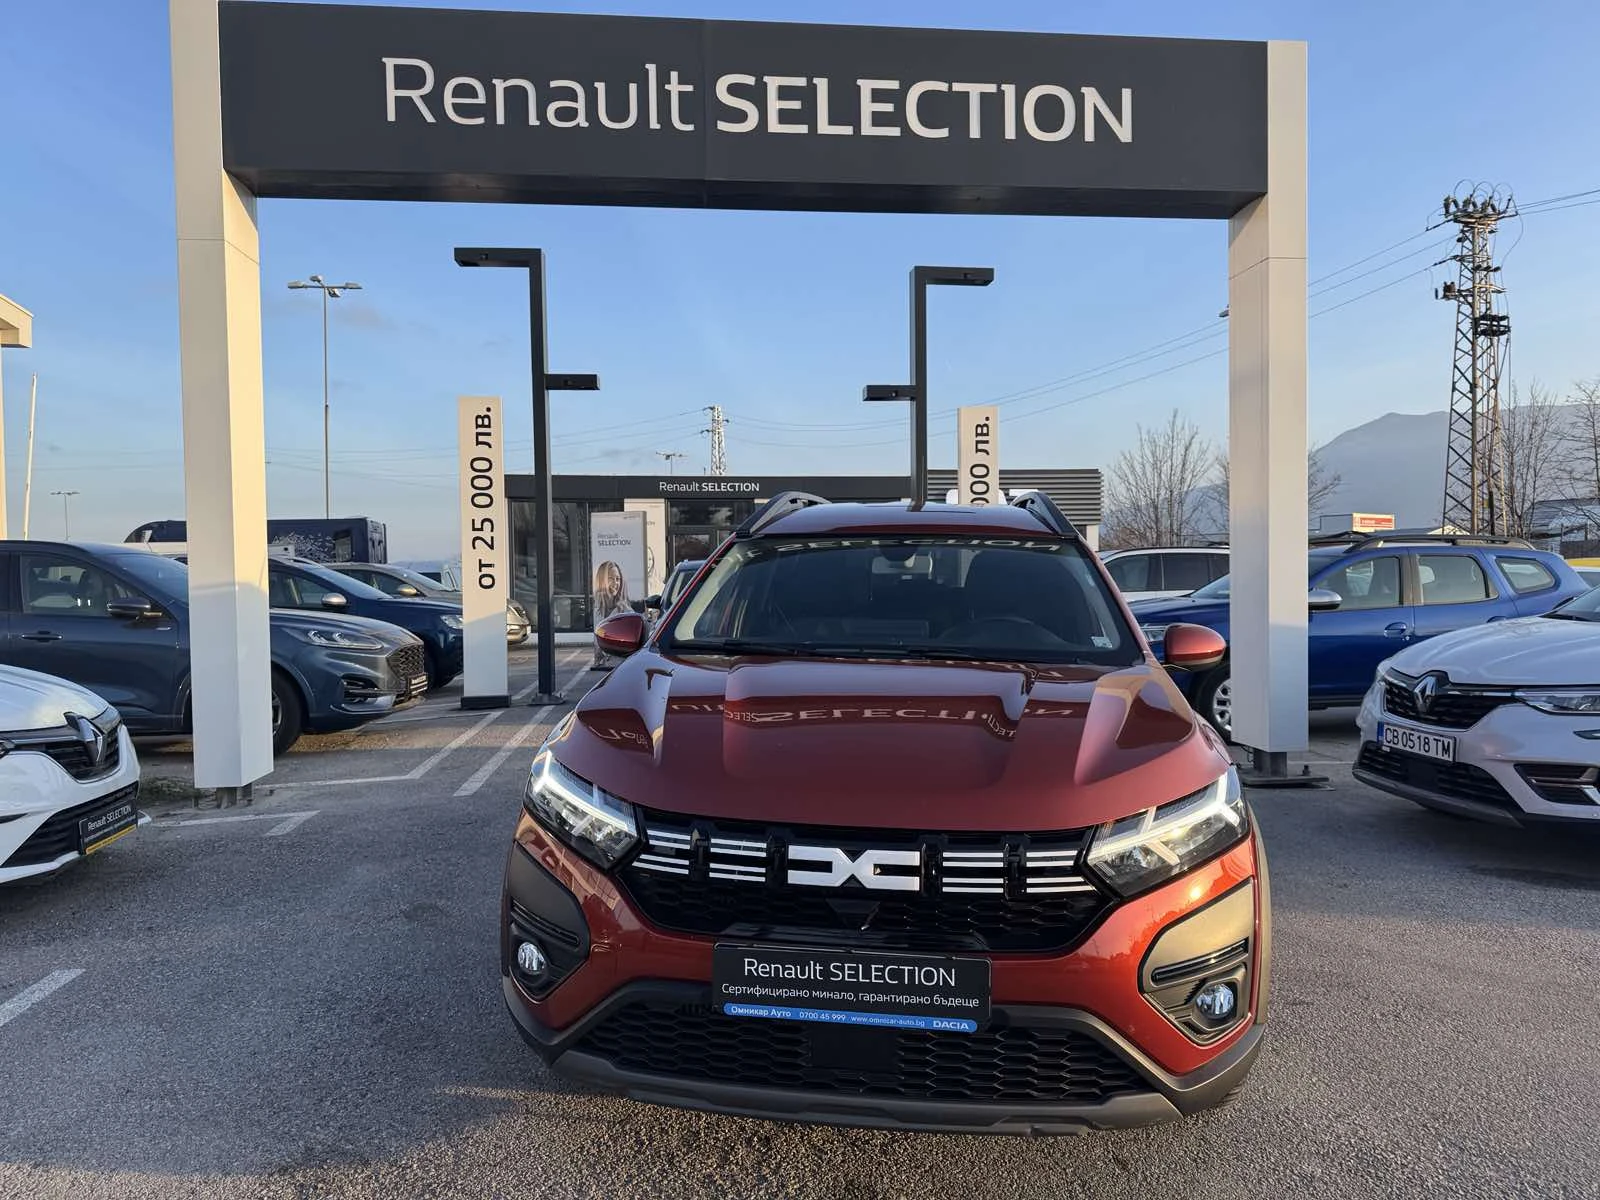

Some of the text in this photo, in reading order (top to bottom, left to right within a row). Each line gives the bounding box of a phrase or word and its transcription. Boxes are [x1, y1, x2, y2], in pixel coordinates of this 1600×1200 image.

[382, 56, 1133, 143] Renault SELECTION
[975, 415, 990, 456] лв.
[469, 406, 496, 590] от 25 000 лв.
[659, 481, 760, 492] Renault SELECTION
[1384, 727, 1451, 759] CB 0518 TM
[87, 816, 106, 831] Renault
[106, 804, 132, 823] SELECTION
[743, 957, 955, 987] Renault SELECTION
[721, 983, 980, 1008] Сертифицирано минало, гарантирано бъдеще
[731, 1005, 769, 1017] Омникар
[770, 1008, 792, 1019] Ауто
[799, 1011, 819, 1020] 0700
[819, 1012, 830, 1020] 45
[831, 1013, 846, 1021] 999
[932, 1020, 969, 1030] DACIA
